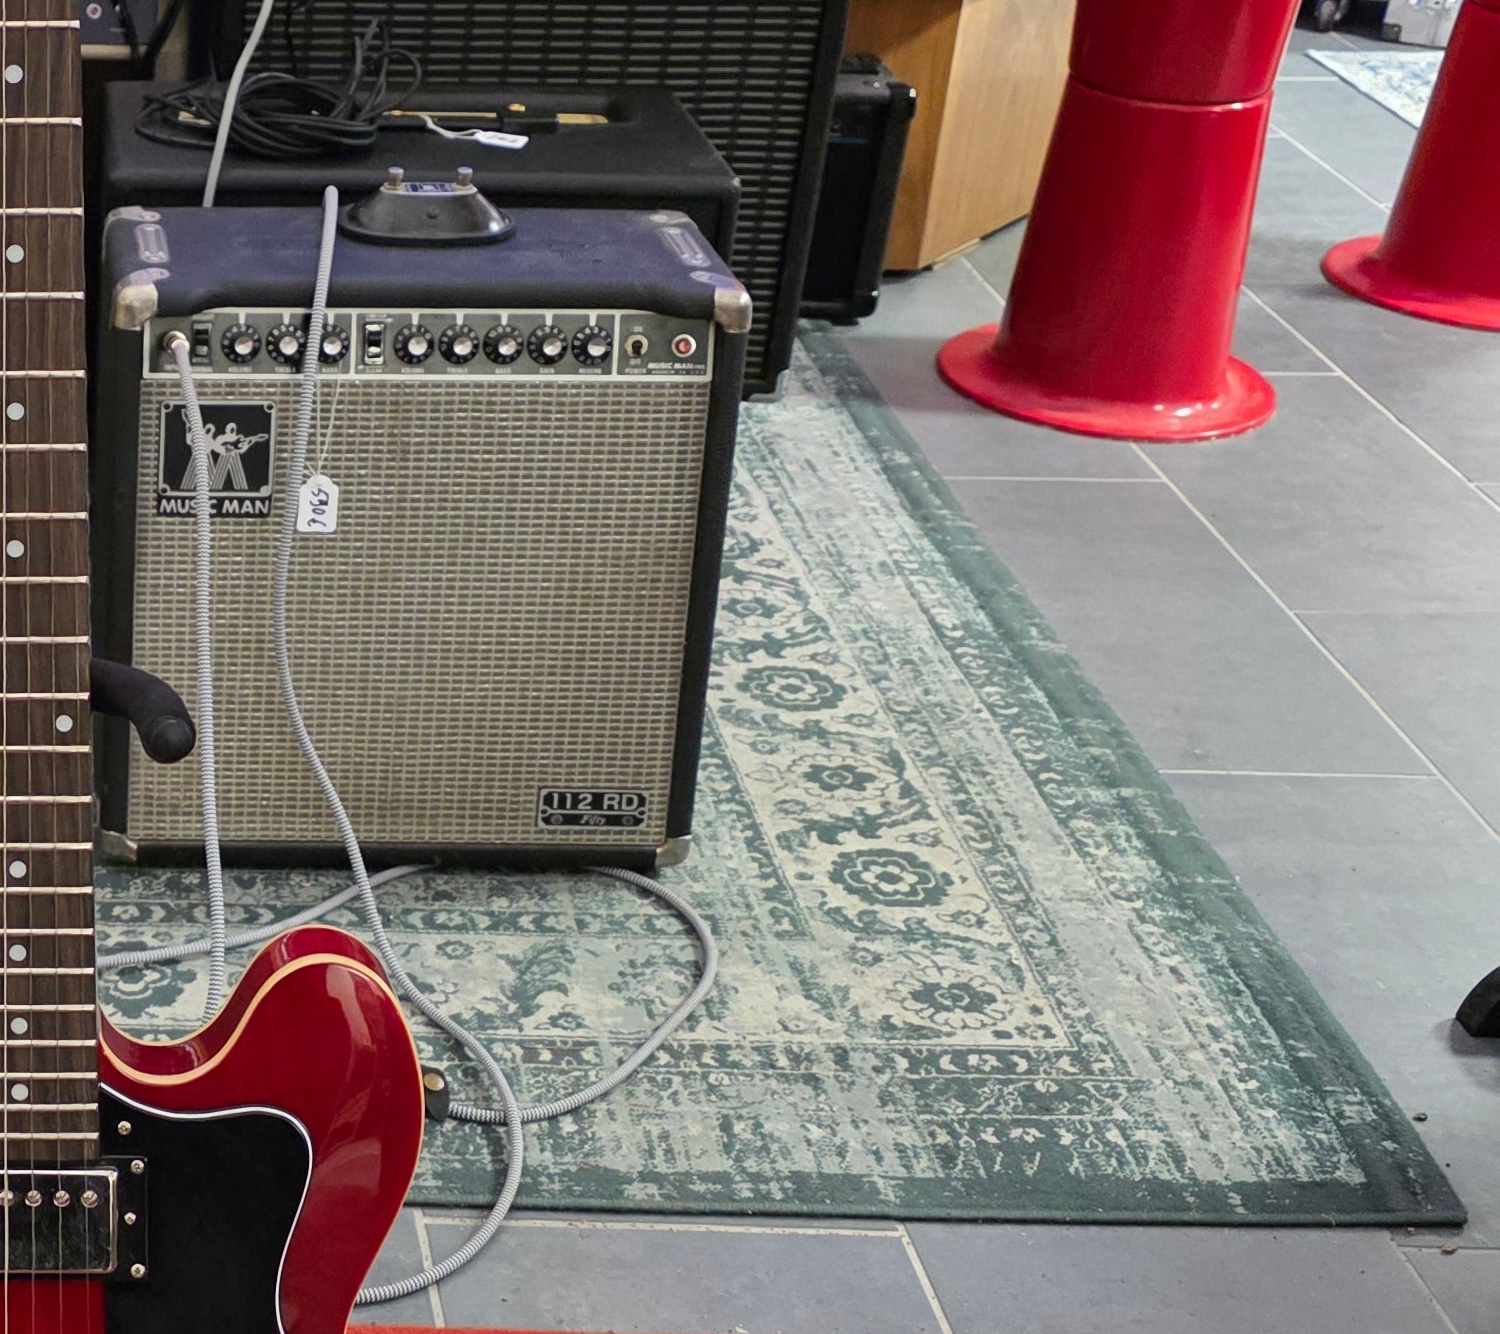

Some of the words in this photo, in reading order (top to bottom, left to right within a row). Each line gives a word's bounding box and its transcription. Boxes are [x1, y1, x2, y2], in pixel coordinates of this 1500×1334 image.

[221, 499, 269, 514] MAN
[552, 792, 593, 810] 112
[603, 793, 639, 811] RD
